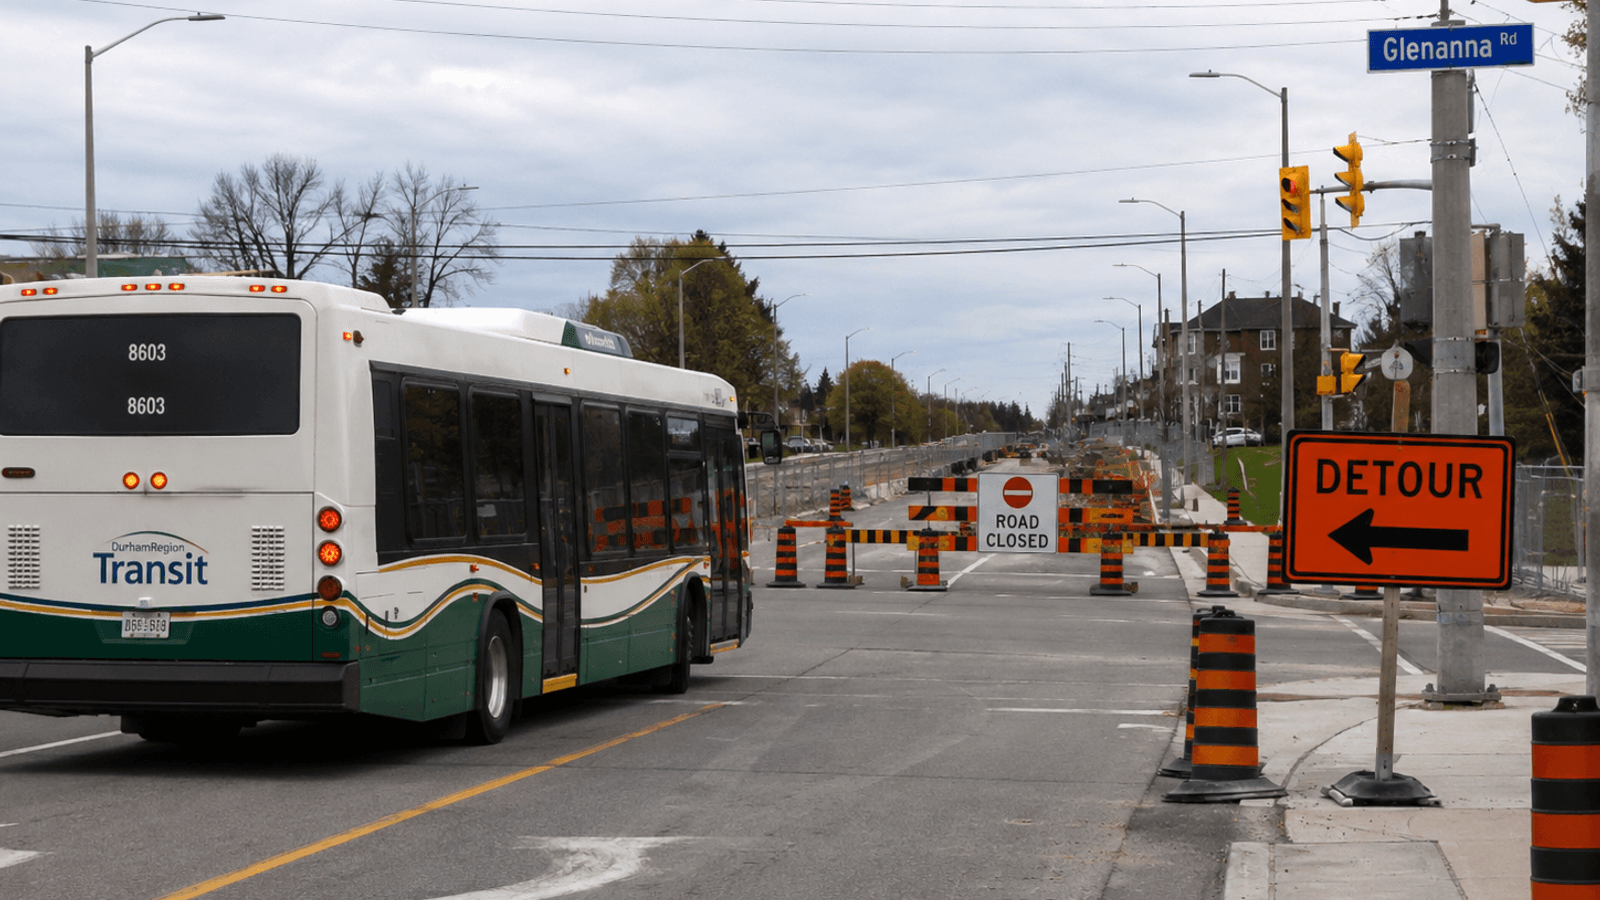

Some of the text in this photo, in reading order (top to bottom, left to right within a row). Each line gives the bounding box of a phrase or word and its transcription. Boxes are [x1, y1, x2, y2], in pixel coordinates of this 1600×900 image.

[1383, 31, 1518, 62] Glenanna Rd
[128, 343, 166, 361] 8603
[127, 396, 165, 415] 8603
[1315, 458, 1484, 499] DETOUR
[996, 514, 1040, 530] ROAD
[986, 533, 1049, 549] CLOSED
[93, 552, 208, 585] Transit
